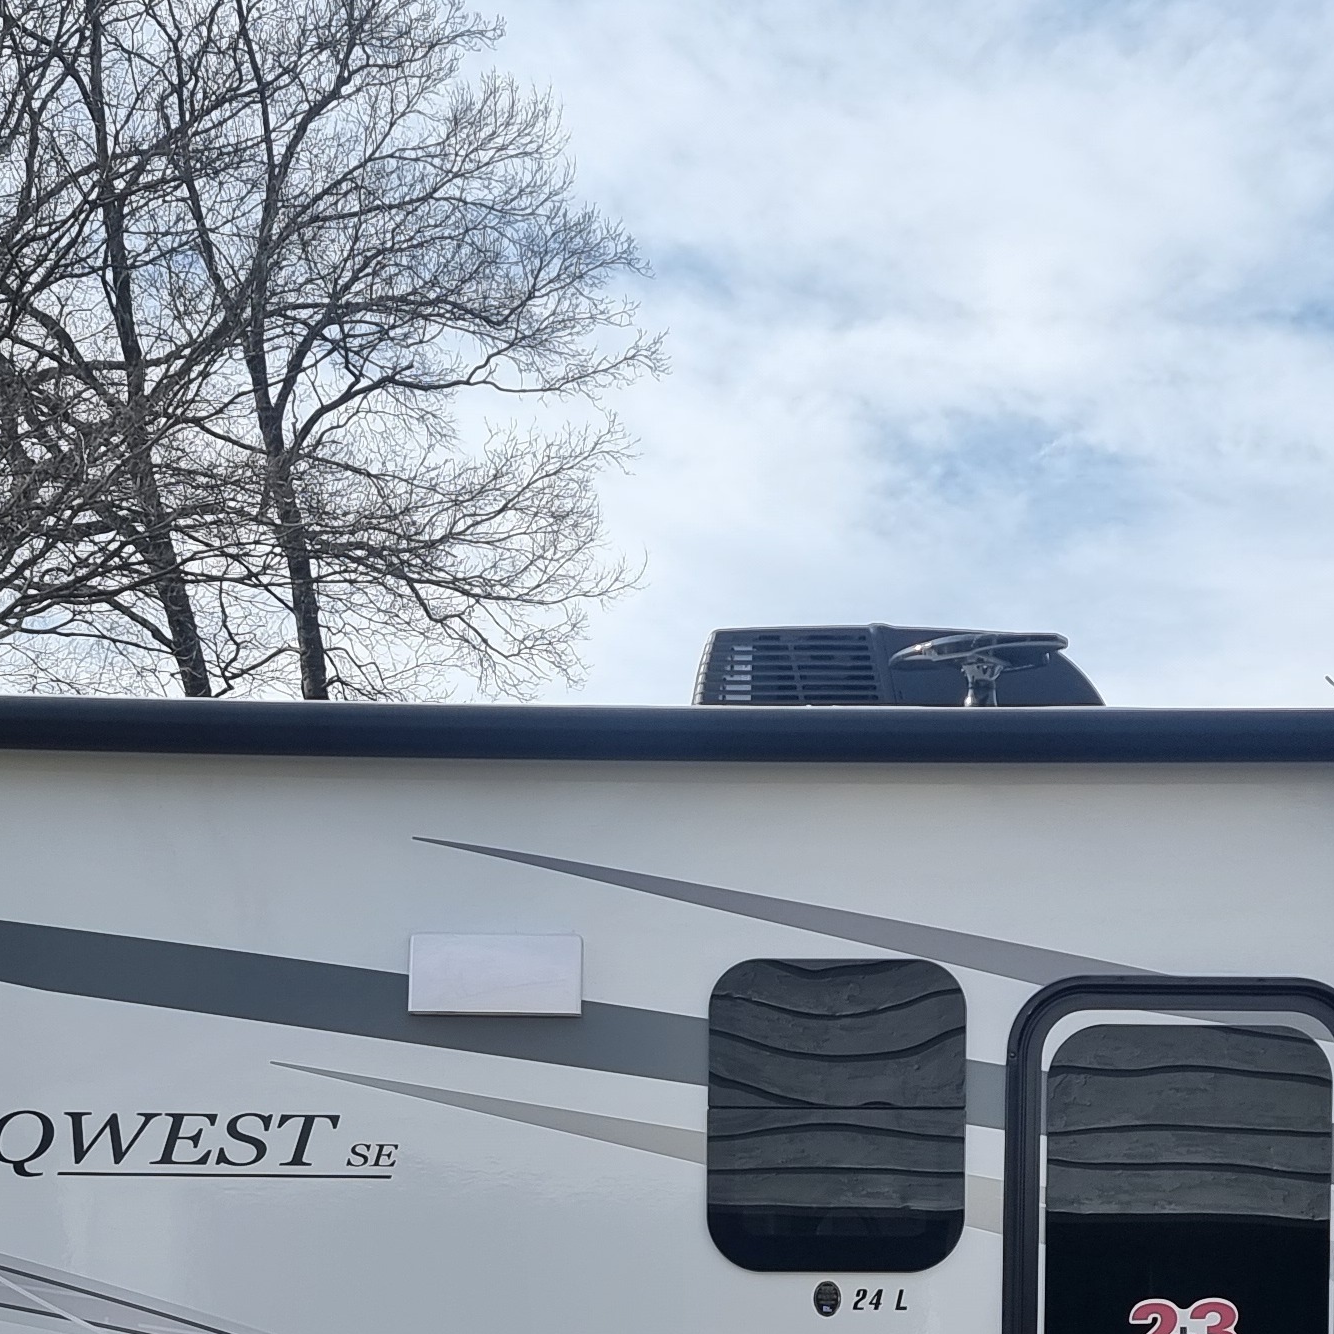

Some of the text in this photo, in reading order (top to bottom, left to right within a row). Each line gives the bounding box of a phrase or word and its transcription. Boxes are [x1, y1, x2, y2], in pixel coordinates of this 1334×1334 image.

[346, 1142, 400, 1168] SE
[852, 1288, 884, 1311] 24
[894, 1288, 908, 1311] L
